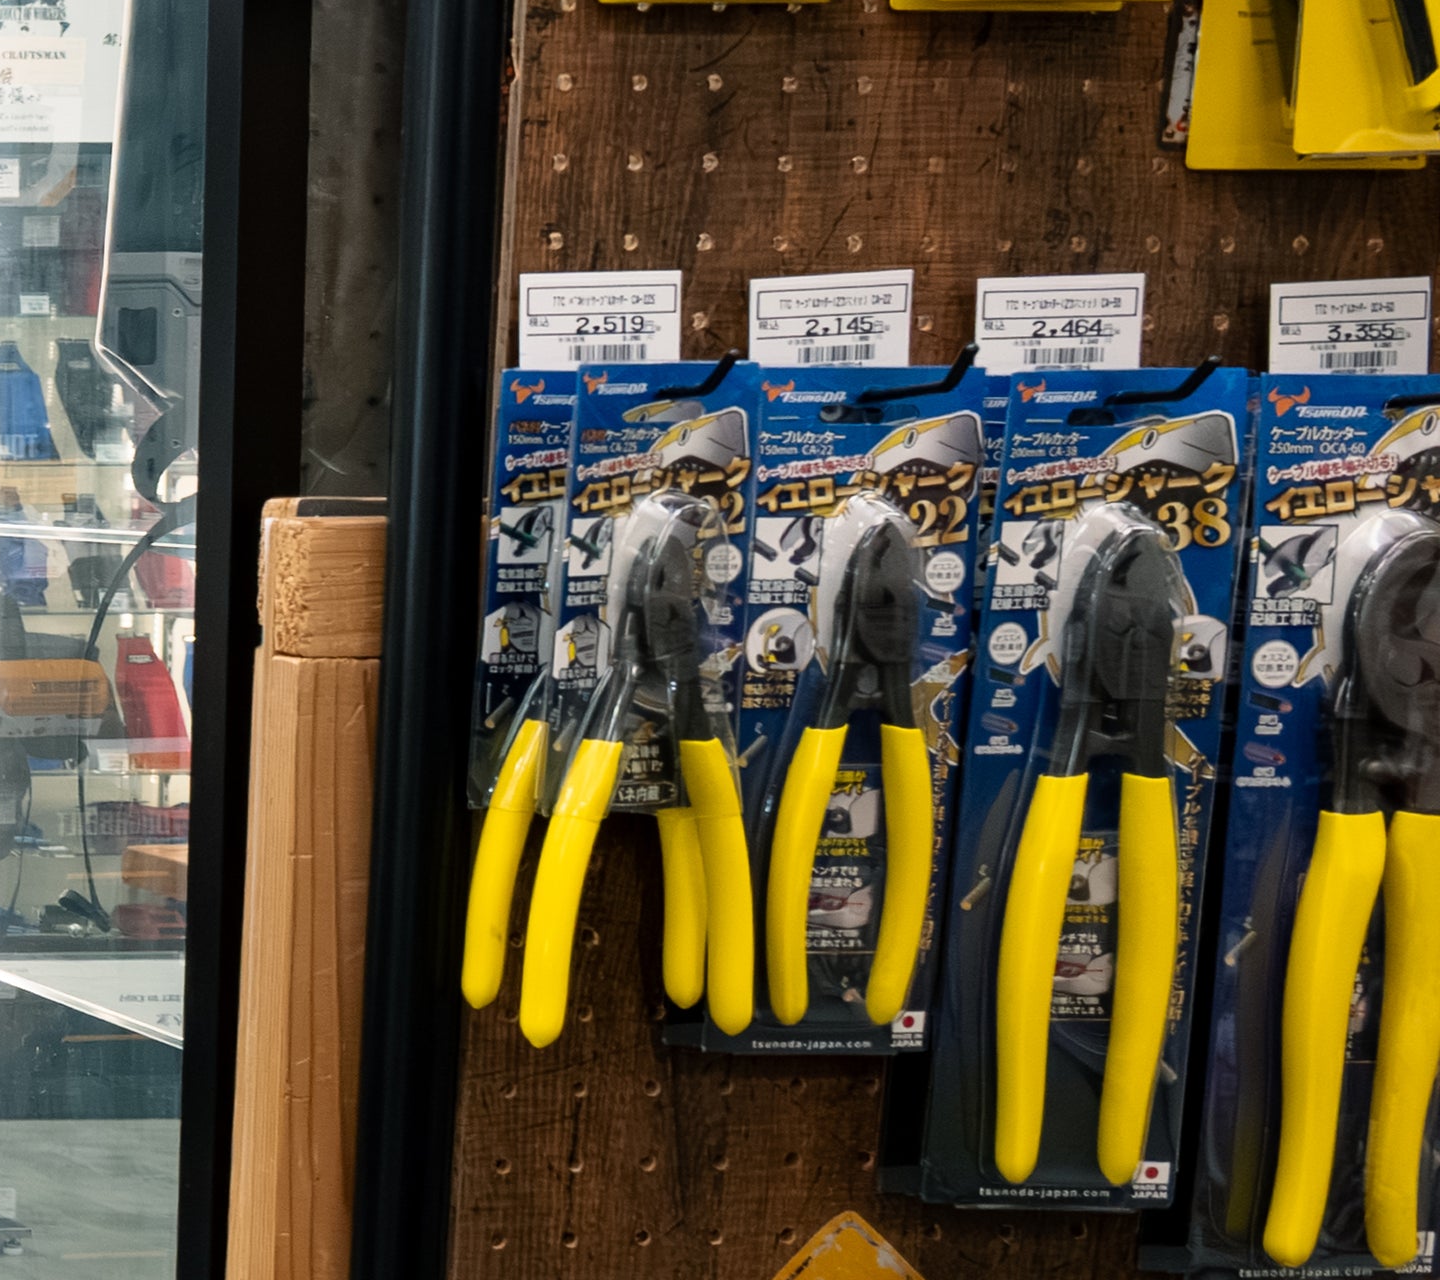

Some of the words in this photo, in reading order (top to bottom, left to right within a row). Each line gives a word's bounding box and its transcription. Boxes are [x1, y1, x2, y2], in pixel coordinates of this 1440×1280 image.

[758, 445, 798, 455] 150mm
[801, 444, 833, 455] CA-22
[1269, 442, 1314, 455] 250mm
[1319, 441, 1367, 455] OCA-60
[910, 493, 969, 548] 22
[1157, 496, 1232, 553] 38
[752, 1038, 874, 1051] tsunoda-japan.com
[978, 1186, 1112, 1200] tsunoda-japan.com
